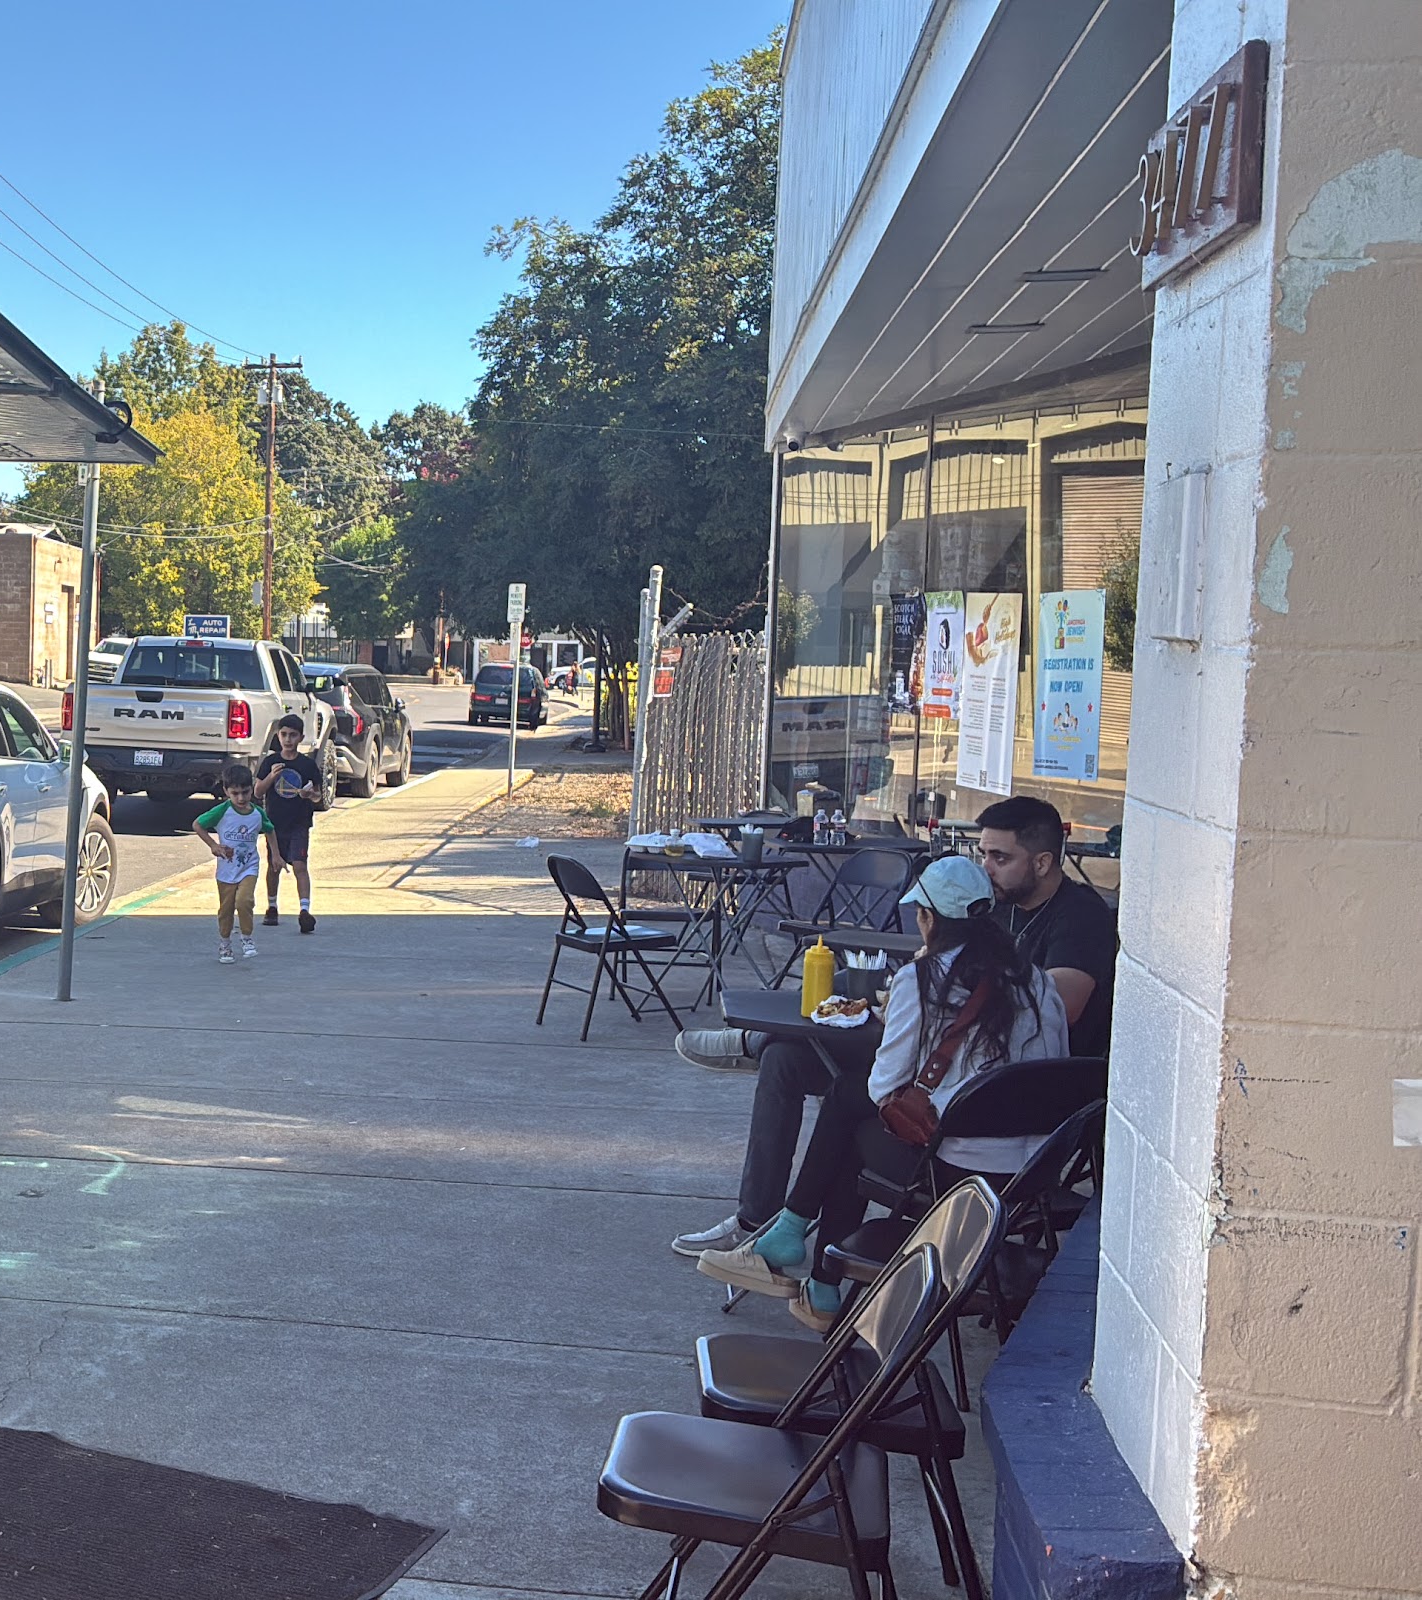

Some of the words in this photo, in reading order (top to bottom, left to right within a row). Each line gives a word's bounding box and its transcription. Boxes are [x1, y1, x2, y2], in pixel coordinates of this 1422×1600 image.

[1129, 83, 1231, 257] 3477
[894, 604, 915, 613] SCOTCH
[894, 614, 909, 624] STEAK
[895, 625, 912, 635] CIGAR
[1067, 626, 1086, 636] JEWISH
[932, 650, 956, 674] SUSHI
[1044, 658, 1086, 670] REGISTRATION
[1088, 658, 1094, 670] IS
[1050, 681, 1063, 693] NOW
[1065, 681, 1083, 693] OPEN!
[114, 708, 184, 720] RAM
